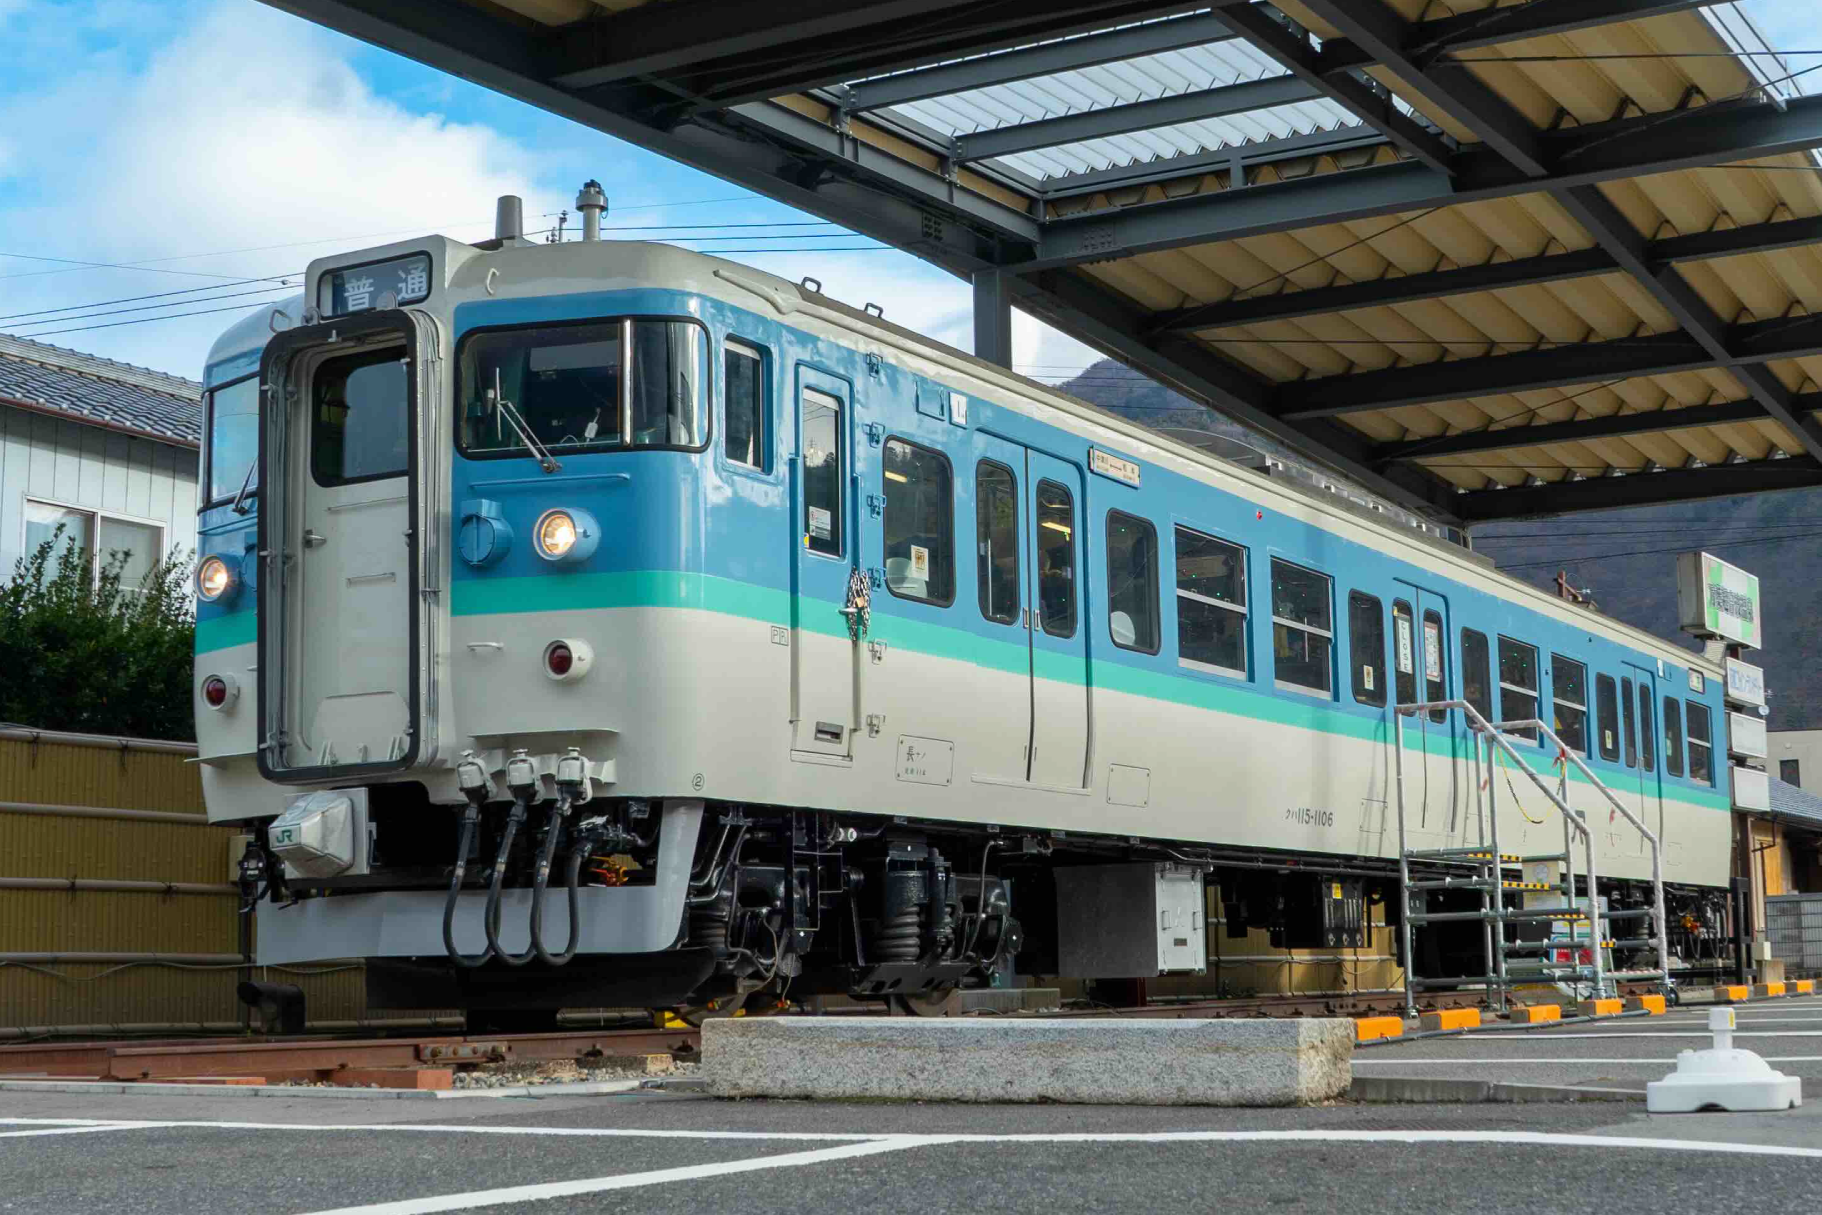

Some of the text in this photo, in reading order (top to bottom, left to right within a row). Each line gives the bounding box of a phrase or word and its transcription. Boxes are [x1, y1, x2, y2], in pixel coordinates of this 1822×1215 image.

[344, 263, 428, 311] 普通
[1401, 622, 1409, 672] CLOSE
[277, 829, 293, 844] JR
